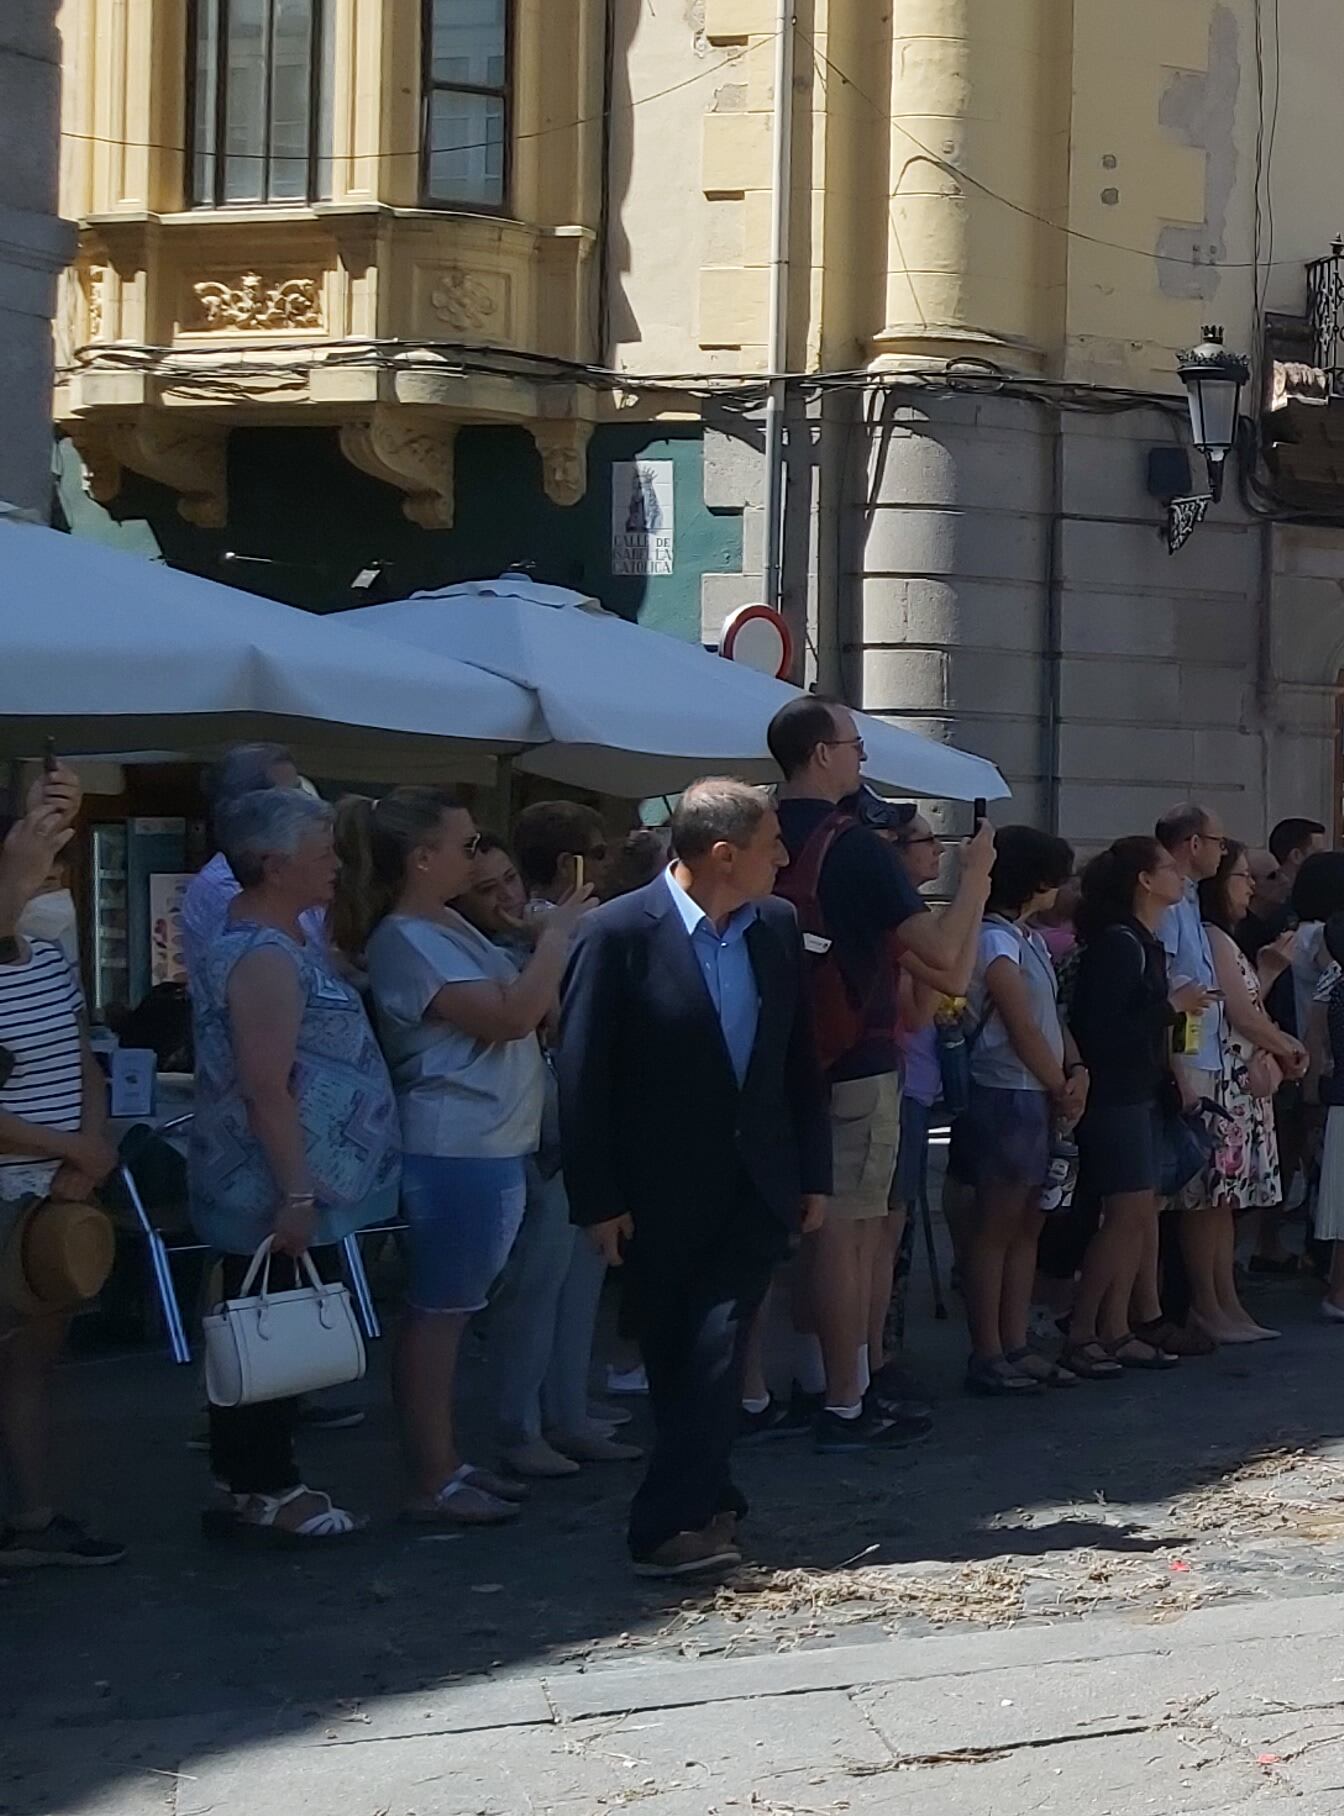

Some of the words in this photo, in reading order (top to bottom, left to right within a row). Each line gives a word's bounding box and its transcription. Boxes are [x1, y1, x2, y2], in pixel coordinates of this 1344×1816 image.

[613, 534, 649, 548] CALLE
[656, 537, 671, 548] DE
[655, 548, 672, 561] LA
